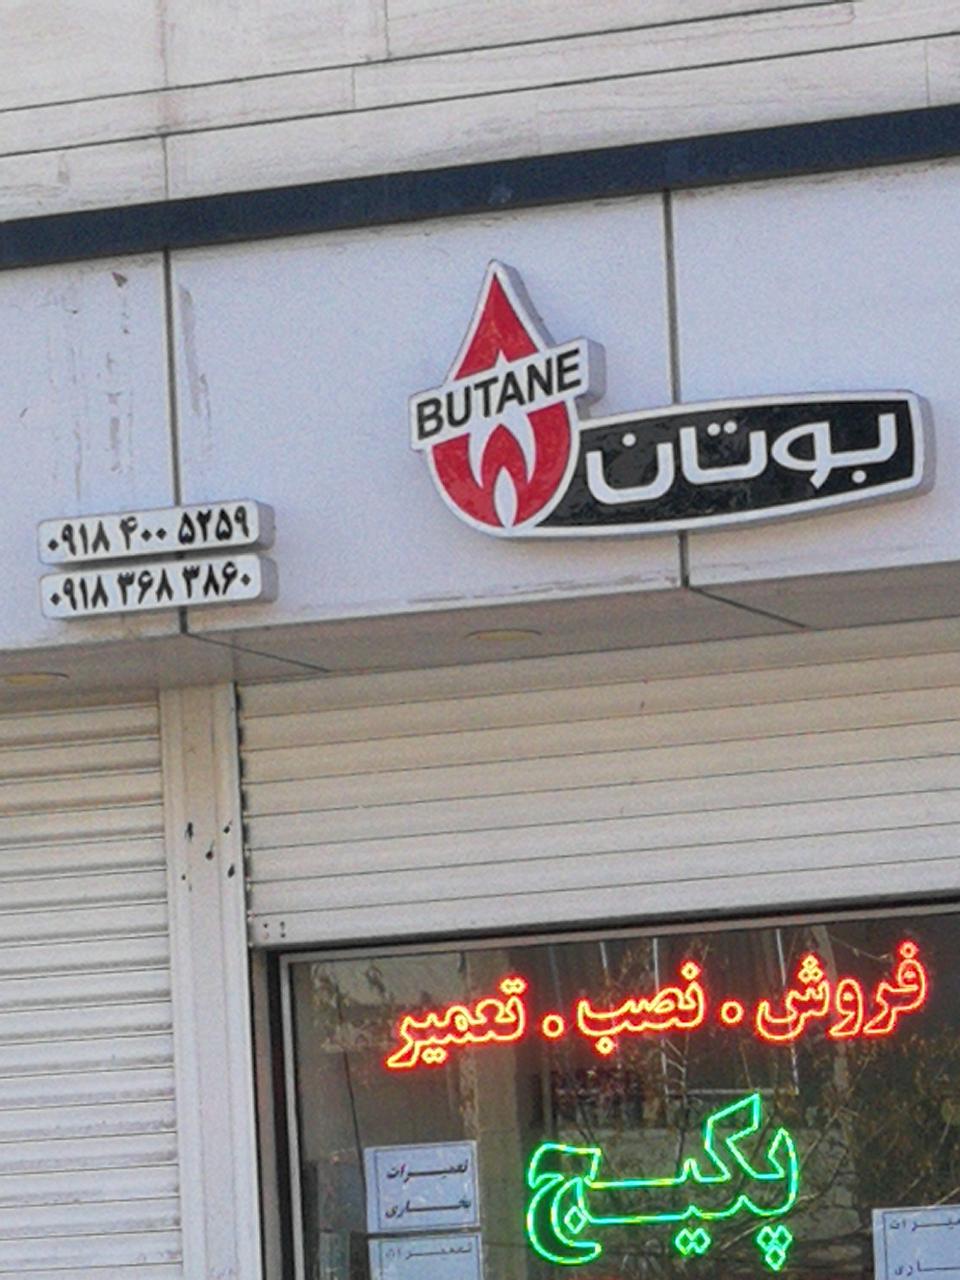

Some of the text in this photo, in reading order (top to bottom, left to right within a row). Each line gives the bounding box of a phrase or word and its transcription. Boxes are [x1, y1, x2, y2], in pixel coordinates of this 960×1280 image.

[415, 347, 583, 440] BUTANE
[585, 413, 898, 505] بوتان
[47, 505, 250, 556] ۰۹۱۸ ۴۰۰ ۵۲۵۹
[49, 561, 252, 611] ۰۹۱۸ ۳۶۸ ۳۸۶۰
[386, 939, 926, 1068] فروش نصب تعمیر
[527, 1092, 800, 1271] پکیج
